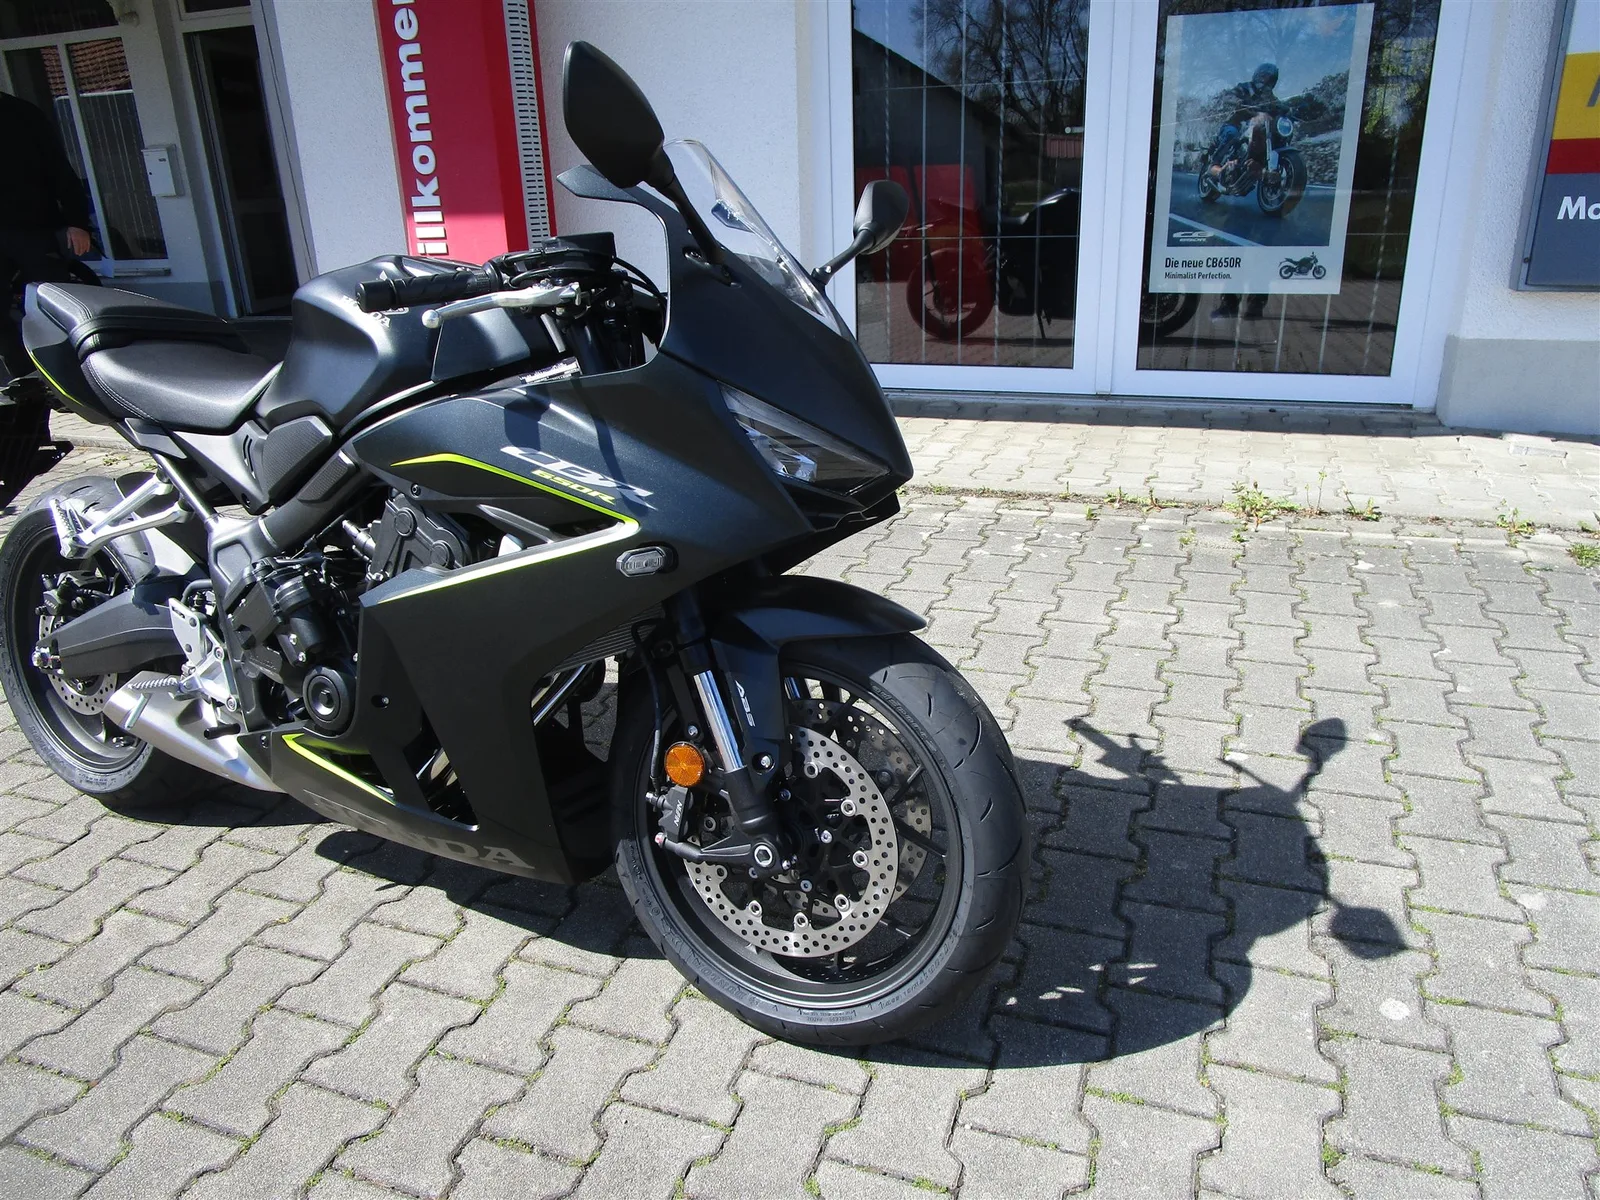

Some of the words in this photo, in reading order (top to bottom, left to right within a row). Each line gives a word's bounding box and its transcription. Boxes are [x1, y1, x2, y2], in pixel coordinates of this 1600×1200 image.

[392, 0, 449, 255] illkomme
[1164, 257, 1180, 268] Die
[1181, 259, 1204, 268] neue
[1206, 257, 1242, 268] CB650R
[1164, 271, 1197, 280] Minimalist
[1197, 271, 1233, 280] Perfection.
[531, 469, 616, 506] 650R
[734, 679, 755, 728] ABS
